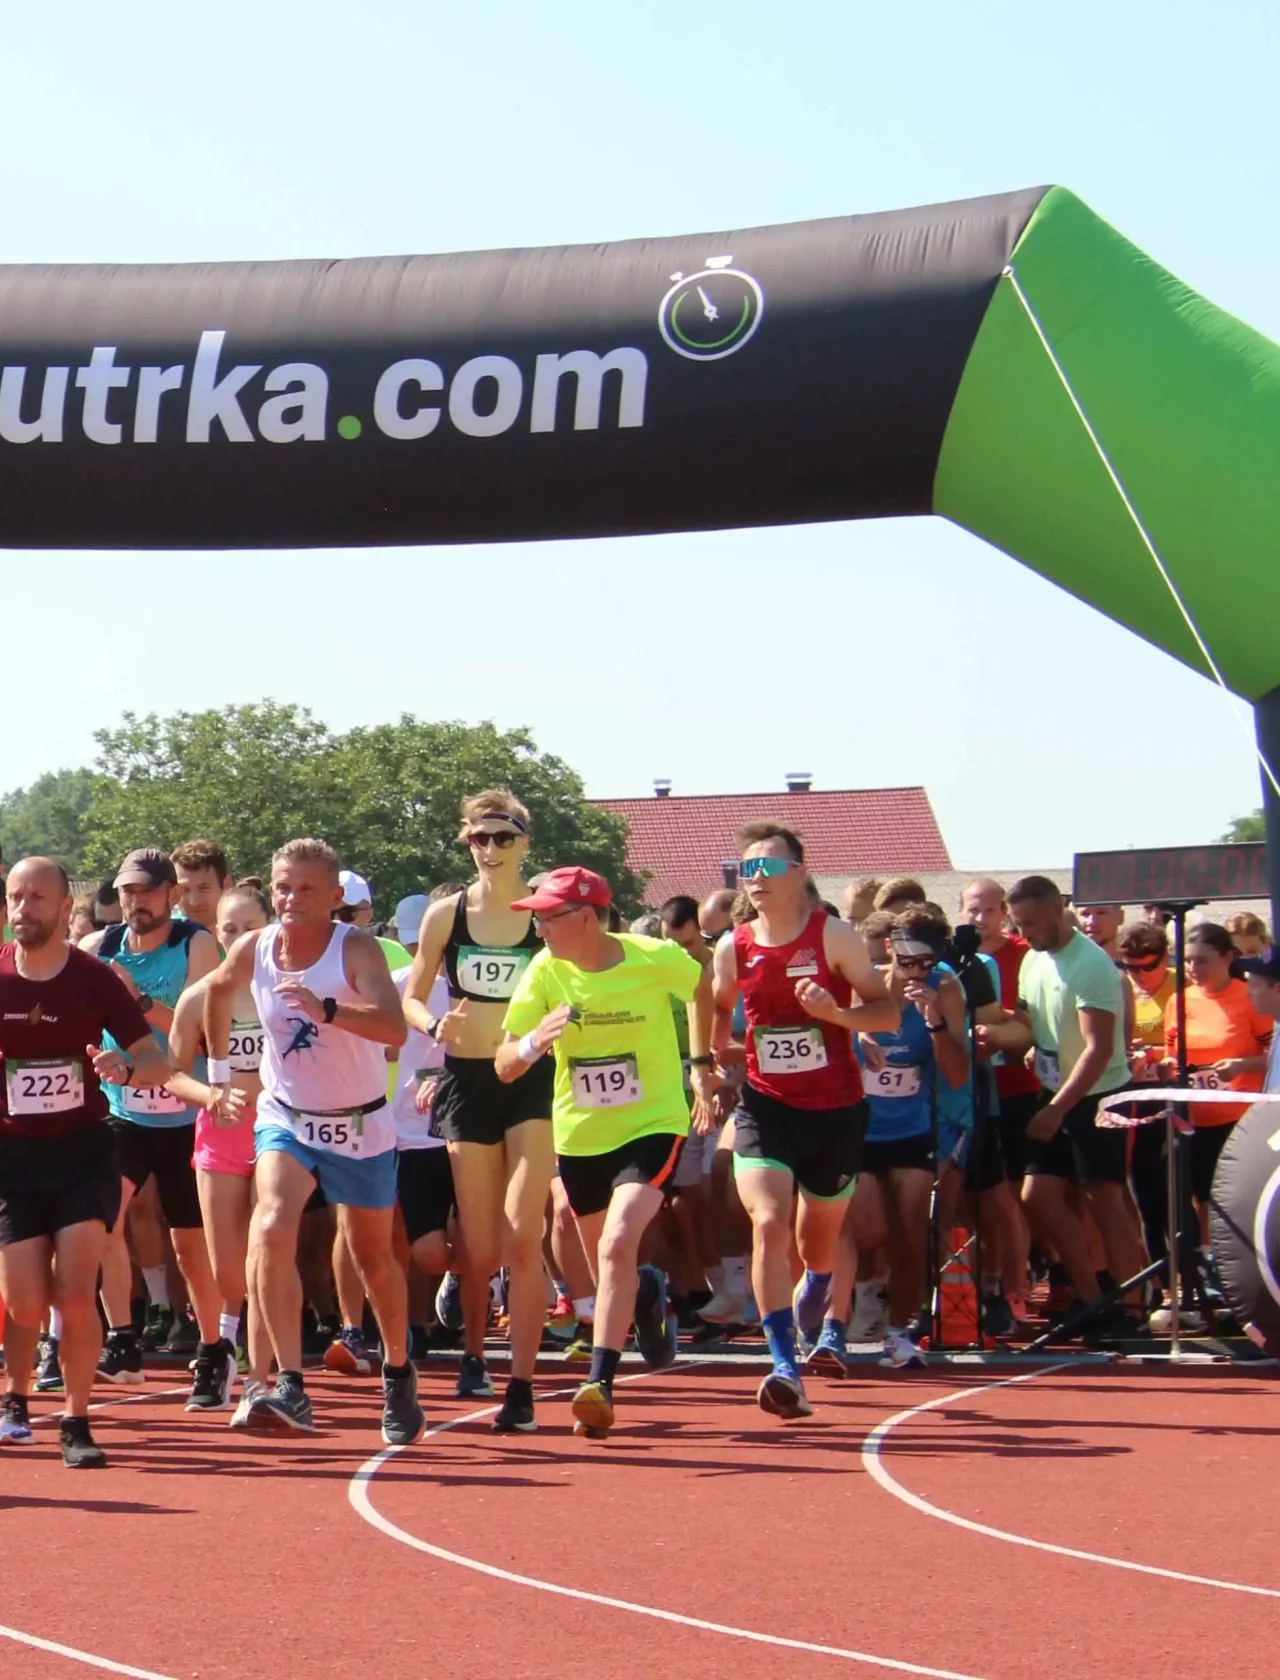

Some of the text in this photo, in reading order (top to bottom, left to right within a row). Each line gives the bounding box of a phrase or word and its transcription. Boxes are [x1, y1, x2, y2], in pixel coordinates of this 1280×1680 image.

[471, 961, 517, 983] 197
[228, 1034, 265, 1056] 208
[766, 1038, 811, 1060] 236
[21, 1073, 71, 1097] 222
[580, 1070, 625, 1093] 119
[878, 1071, 903, 1087] 61
[304, 1121, 349, 1144] 165
